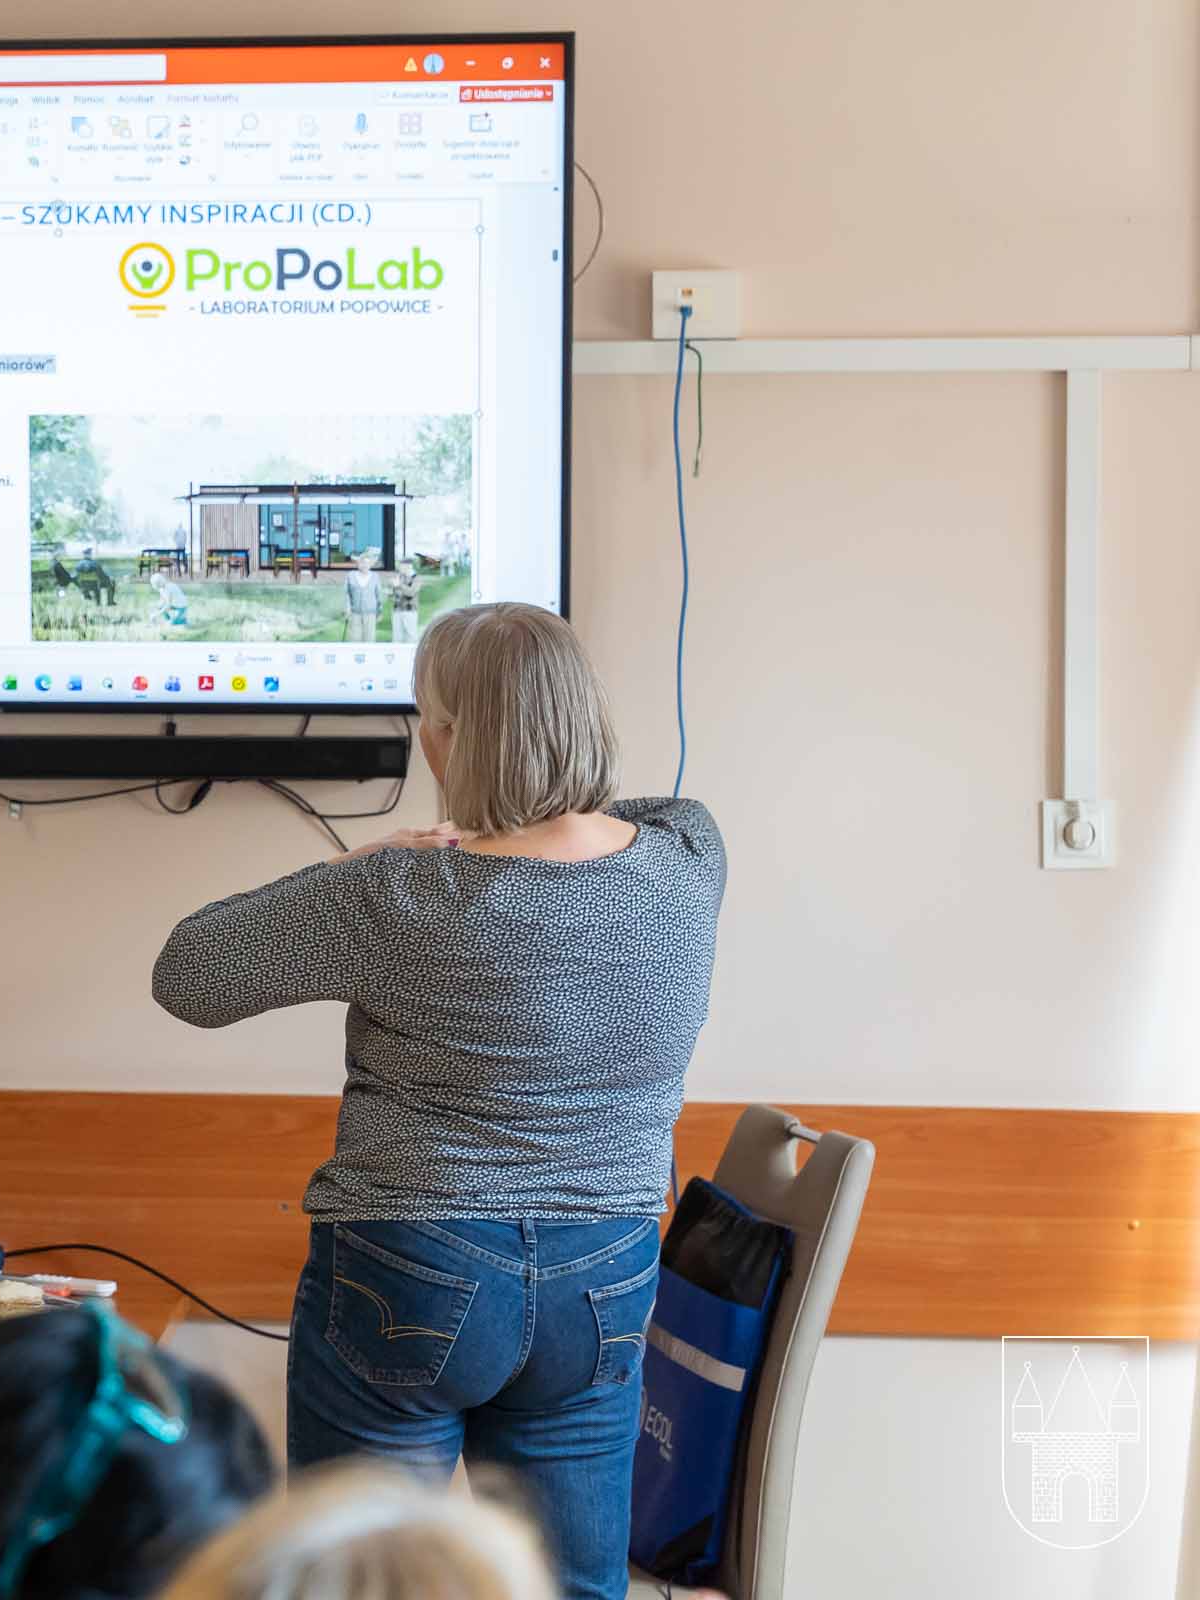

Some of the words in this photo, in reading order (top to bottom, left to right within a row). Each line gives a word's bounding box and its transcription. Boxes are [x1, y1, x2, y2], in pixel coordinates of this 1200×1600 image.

[22, 204, 152, 226] SZUKAMY
[161, 203, 303, 225] INSPIRACJI
[312, 202, 372, 227] (CD.)
[185, 246, 445, 292] ProPoLab
[200, 300, 334, 315] LABORATORIUM
[340, 299, 432, 314] POPOWICE
